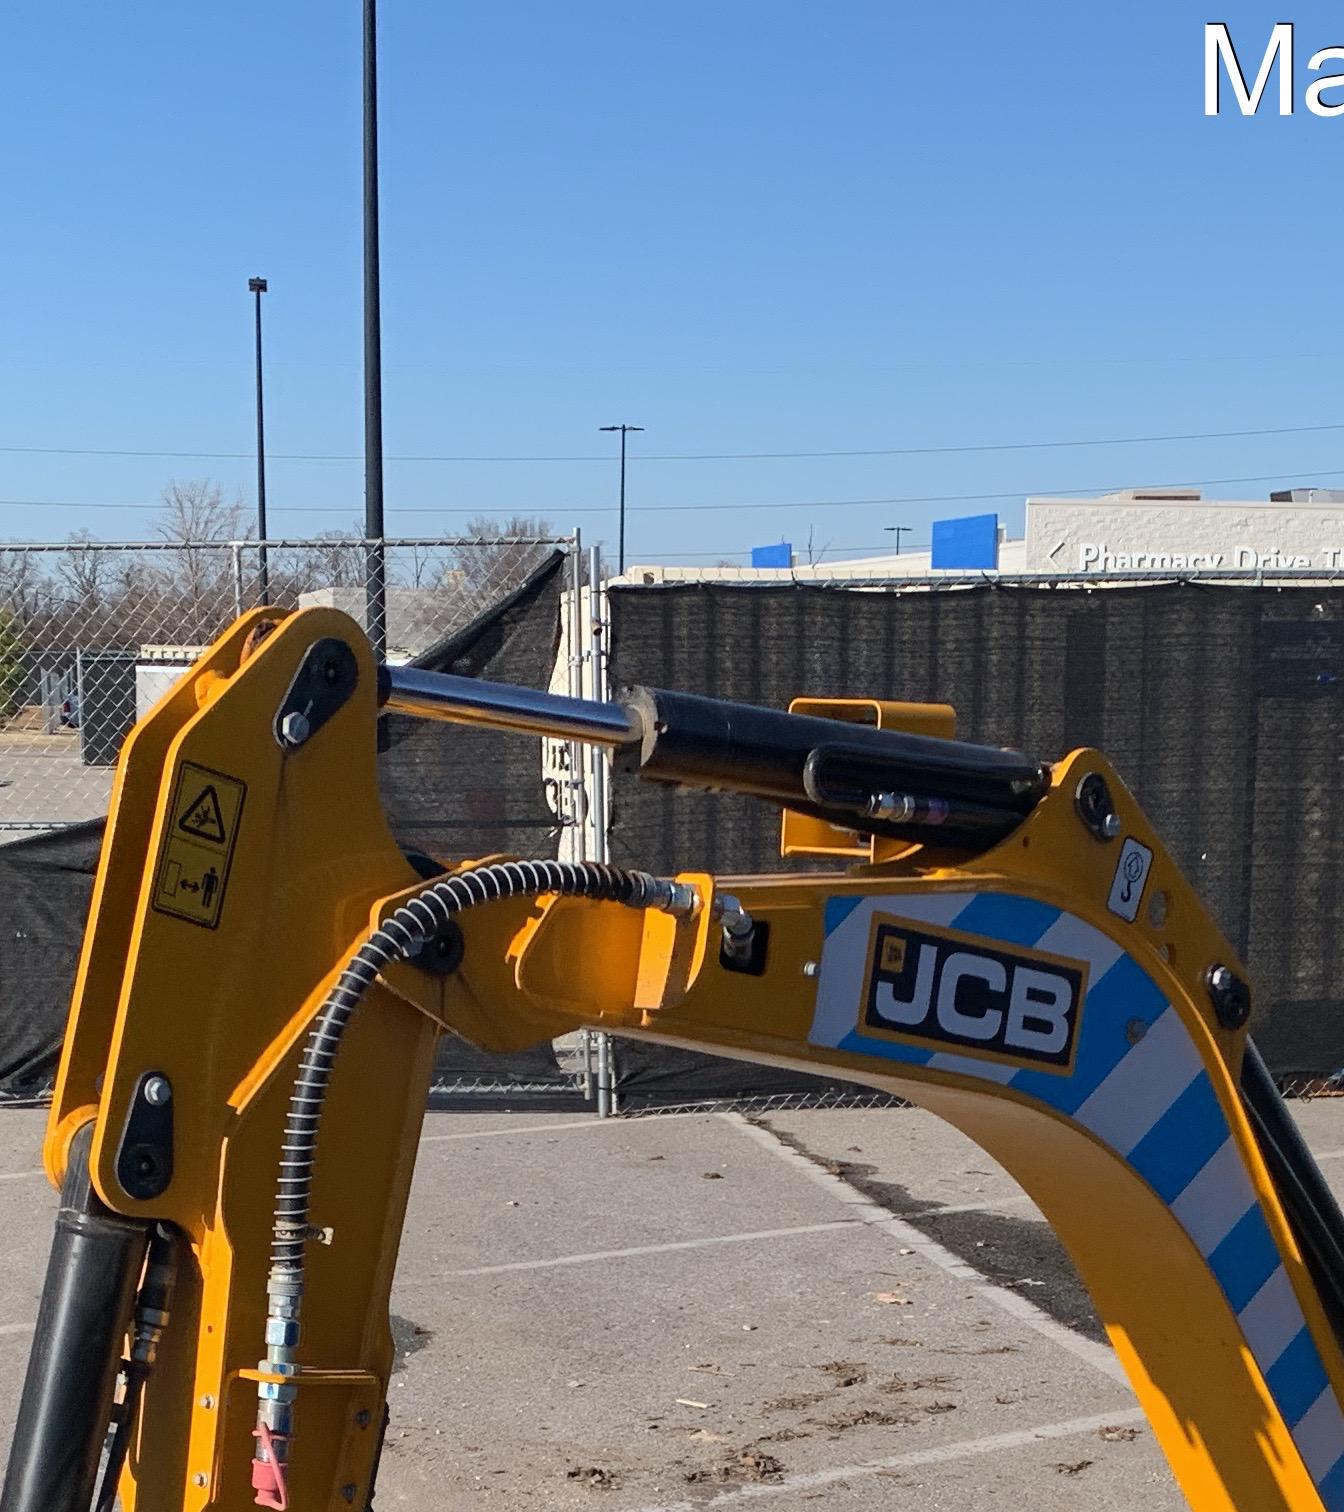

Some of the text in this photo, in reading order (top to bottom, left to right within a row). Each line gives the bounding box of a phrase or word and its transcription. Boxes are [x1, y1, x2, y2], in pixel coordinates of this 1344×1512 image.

[1079, 542, 1224, 571] Pharmacy
[1234, 545, 1312, 569] Drive
[875, 943, 1073, 1054] JCB
